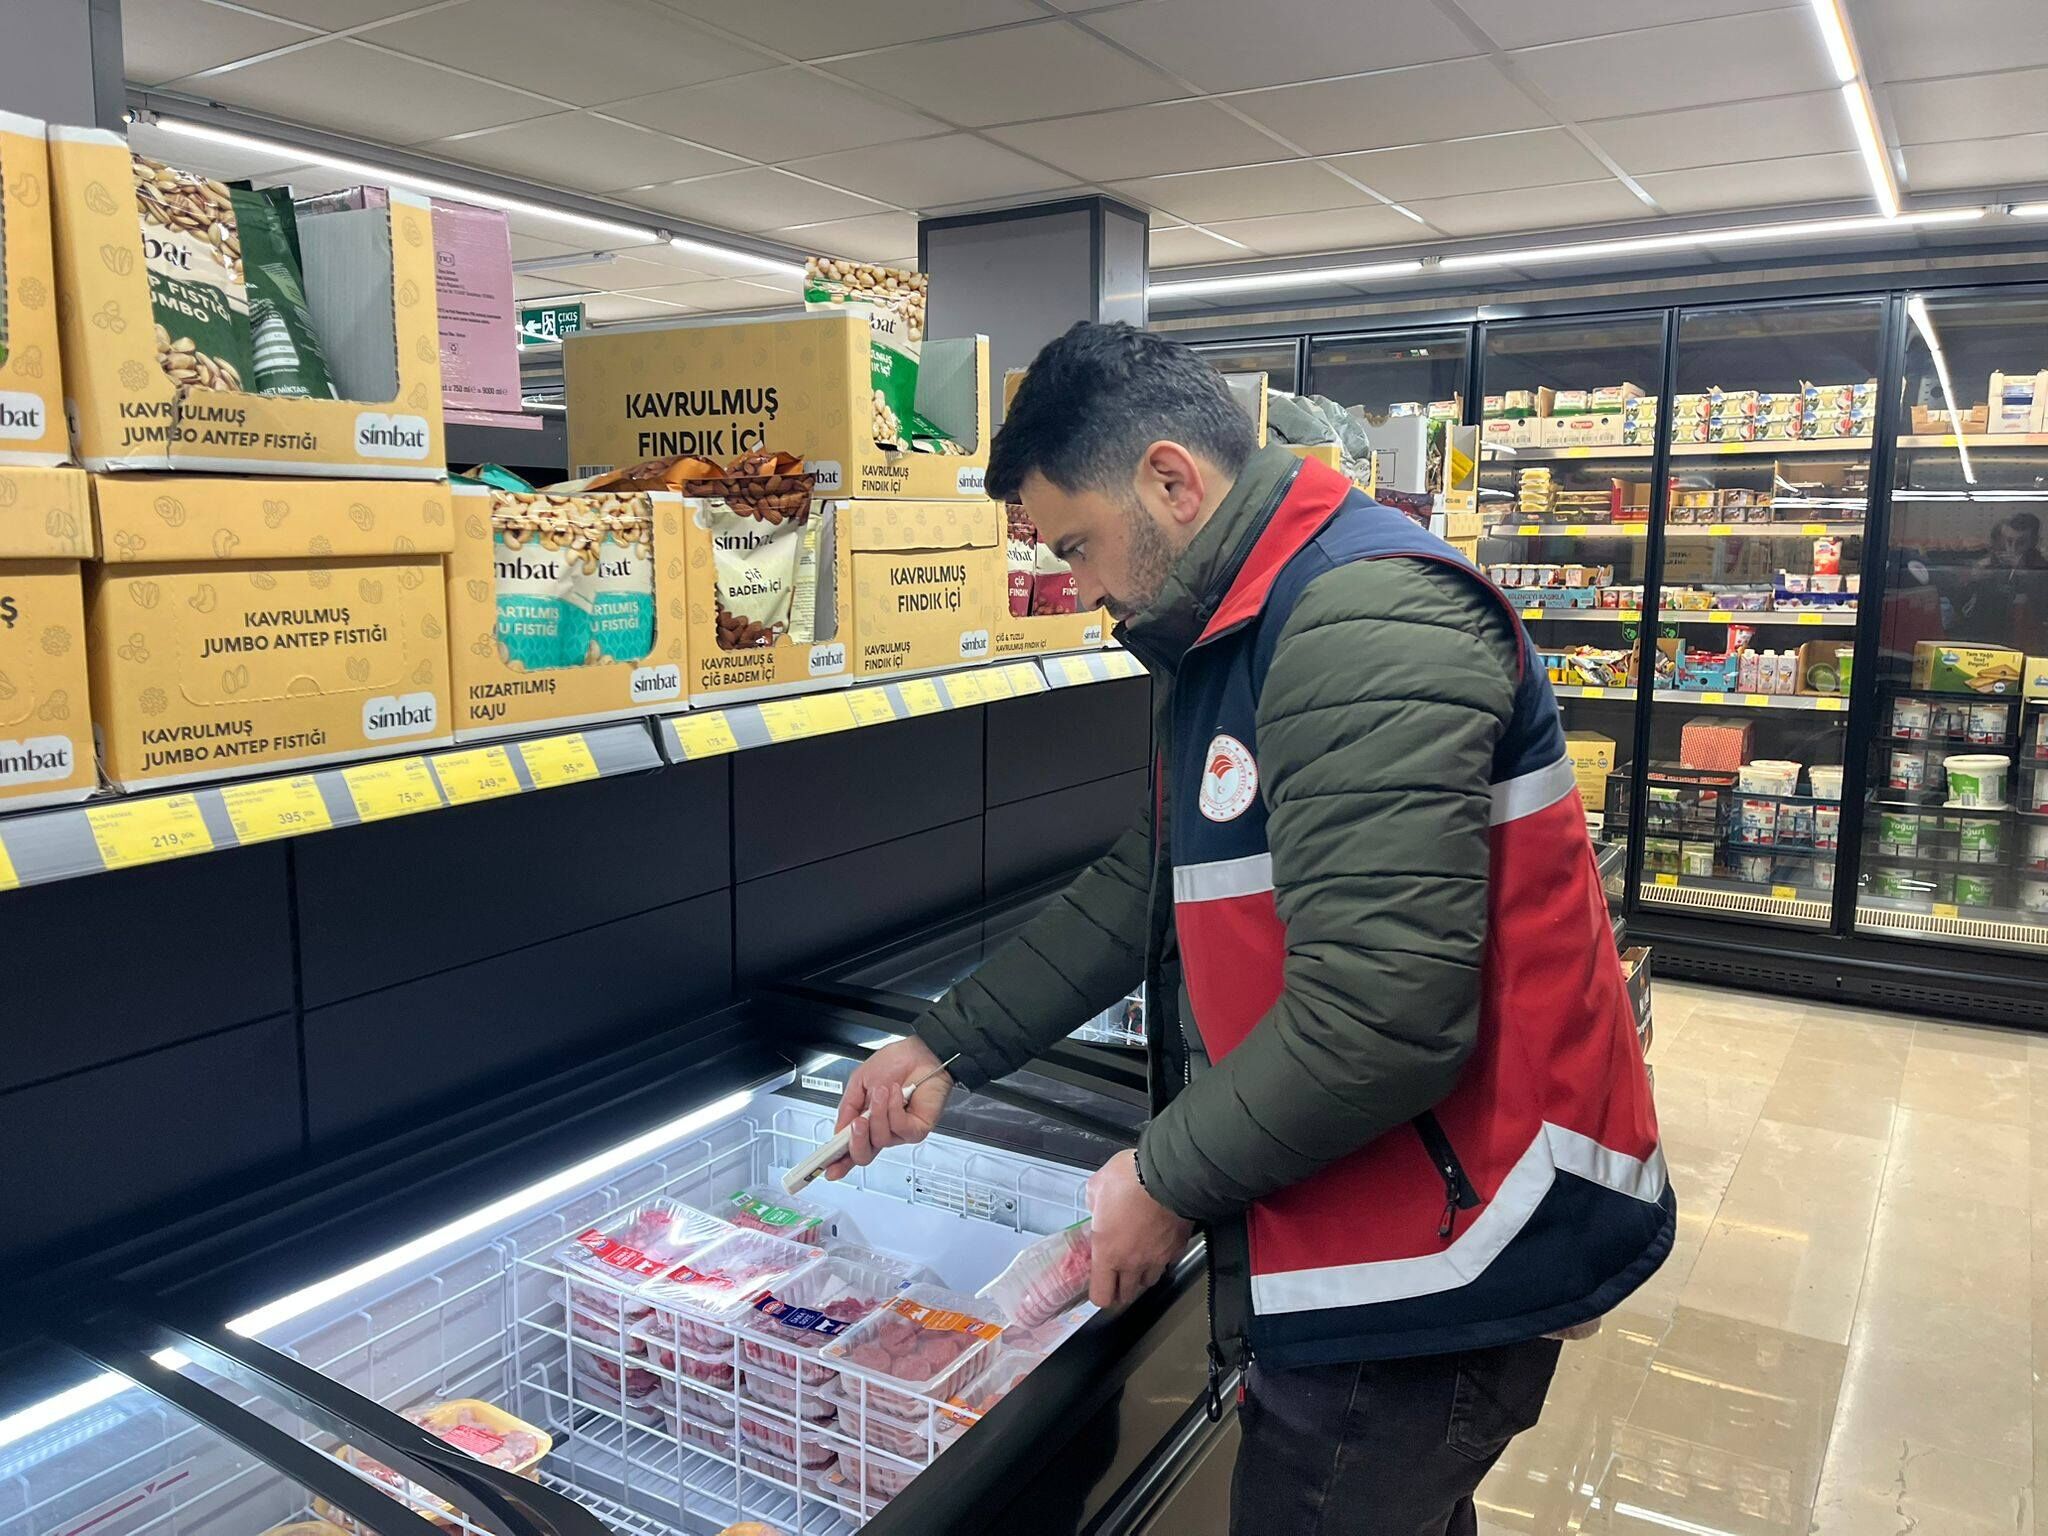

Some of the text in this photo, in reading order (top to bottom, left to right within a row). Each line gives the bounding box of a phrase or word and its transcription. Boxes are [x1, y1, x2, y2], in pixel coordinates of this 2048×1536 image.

[558, 311, 578, 324] ÇIKIŞ
[559, 323, 577, 334] EXIT
[626, 386, 779, 421] KAVRULMUŞ
[202, 429, 259, 448] ANTEP
[264, 431, 317, 451] FISTIĞI
[358, 423, 425, 448] simbat
[637, 429, 725, 457] FINDIK
[862, 464, 909, 480] KAVRULMUŞ
[862, 480, 901, 495] FINDIK İÇİ
[890, 565, 966, 586] KAVRULMUŞ
[898, 587, 961, 613] FINDIK İÇİ
[244, 607, 351, 628] KAVRULMUŞ
[200, 624, 388, 659] JUMBO ANTEP FISTIĞI
[864, 641, 911, 655] KAVRULMUŞ
[961, 638, 987, 652] simbat
[701, 653, 775, 672] KAVRULMUŞ &
[811, 651, 844, 669] simbat
[864, 654, 904, 671] FINDIK İÇİ
[633, 674, 678, 694] simbat
[702, 665, 776, 690] ÇİĞ BADEM İÇİ
[469, 678, 557, 700] KIZARTILMIŞ
[367, 705, 433, 731] simbat
[470, 702, 507, 721] KAJU
[142, 719, 253, 745] KAVRULMUŞ
[141, 728, 326, 772] JUMBO ANTEP FISTIĞI
